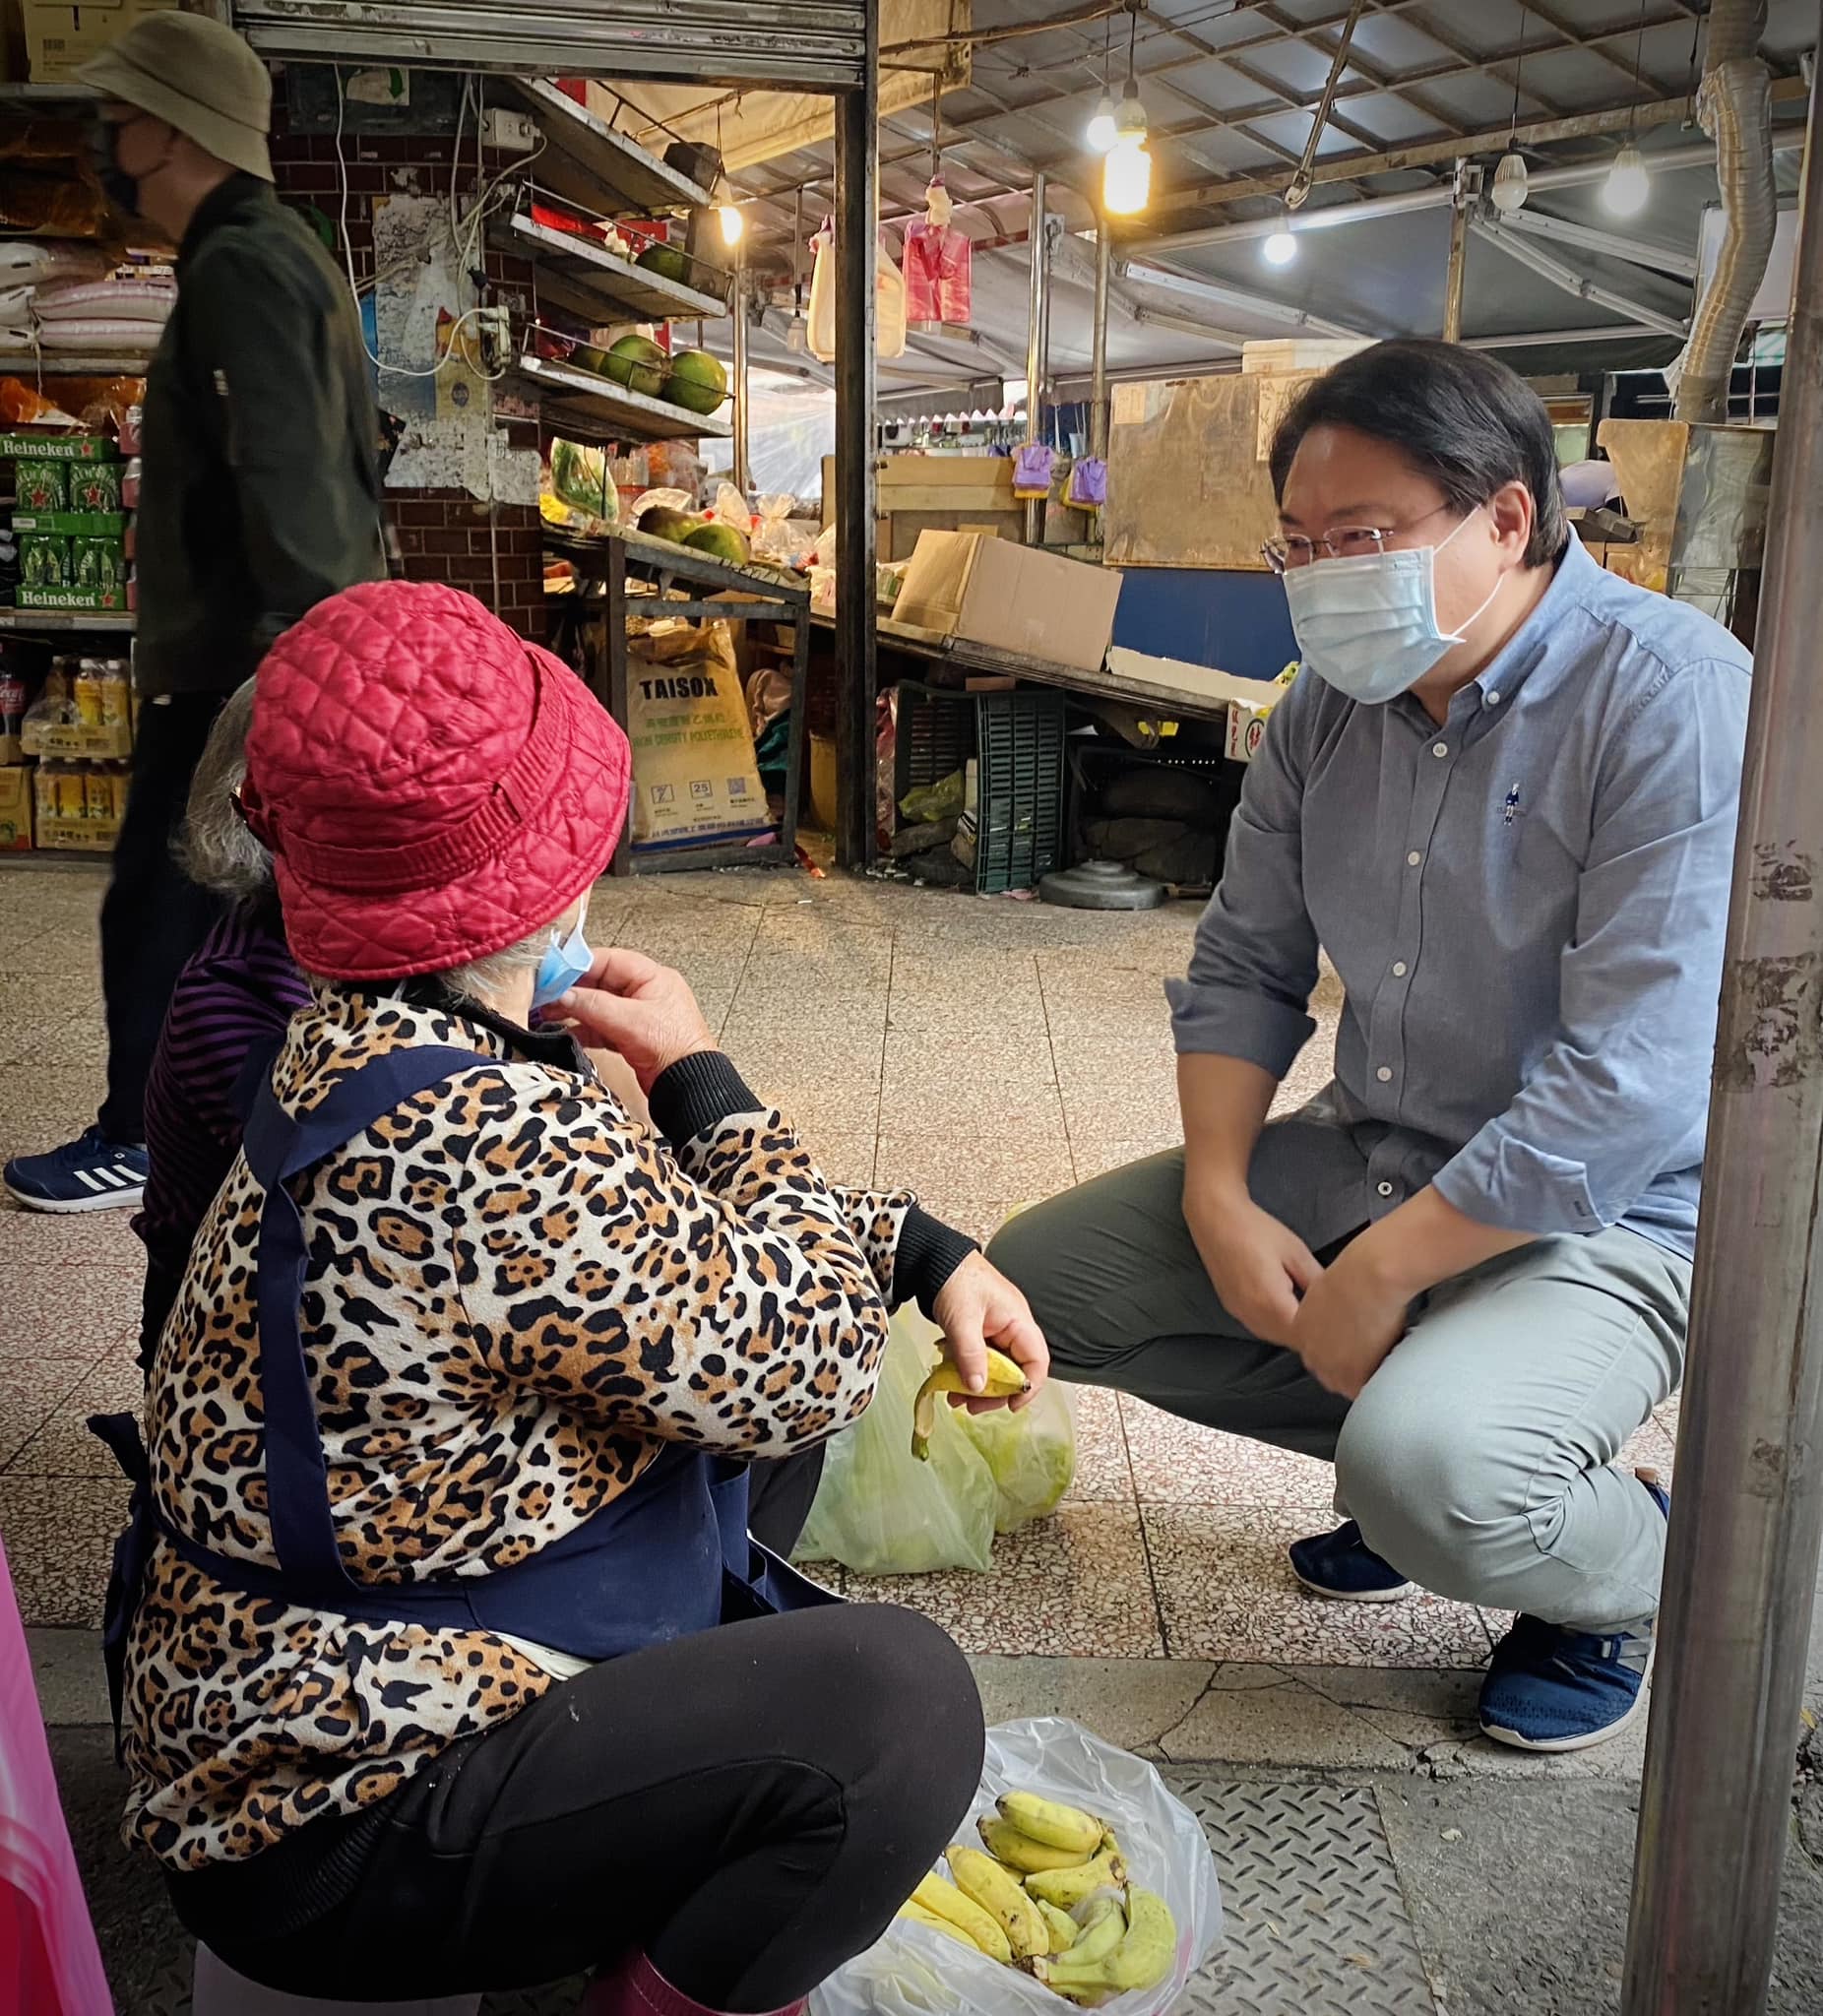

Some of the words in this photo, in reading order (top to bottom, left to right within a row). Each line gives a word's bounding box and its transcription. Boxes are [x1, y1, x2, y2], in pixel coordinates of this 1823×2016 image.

[3, 440, 74, 456] Heineken
[22, 591, 95, 606] Heineken
[639, 676, 719, 700] TAISOX
[693, 784, 709, 793] 25
